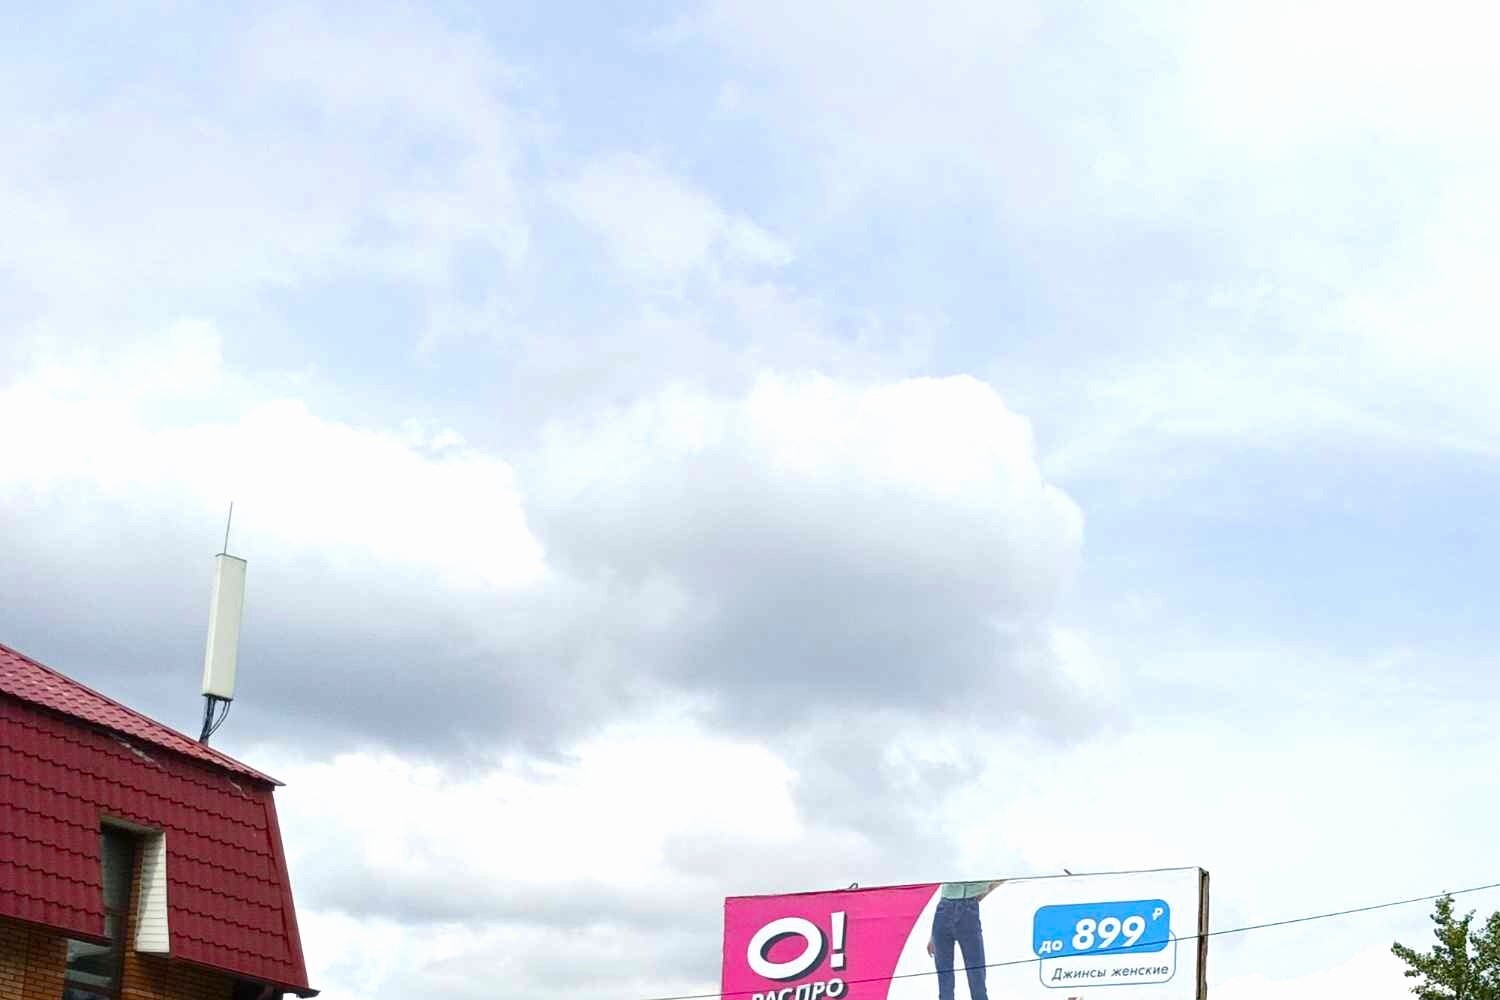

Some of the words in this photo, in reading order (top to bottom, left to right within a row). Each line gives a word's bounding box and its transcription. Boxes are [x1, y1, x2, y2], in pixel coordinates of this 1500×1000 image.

[1039, 940, 1063, 955] до
[1072, 915, 1146, 950] 899
[1051, 967, 1106, 981] Джинсы
[1111, 965, 1169, 977] женские
